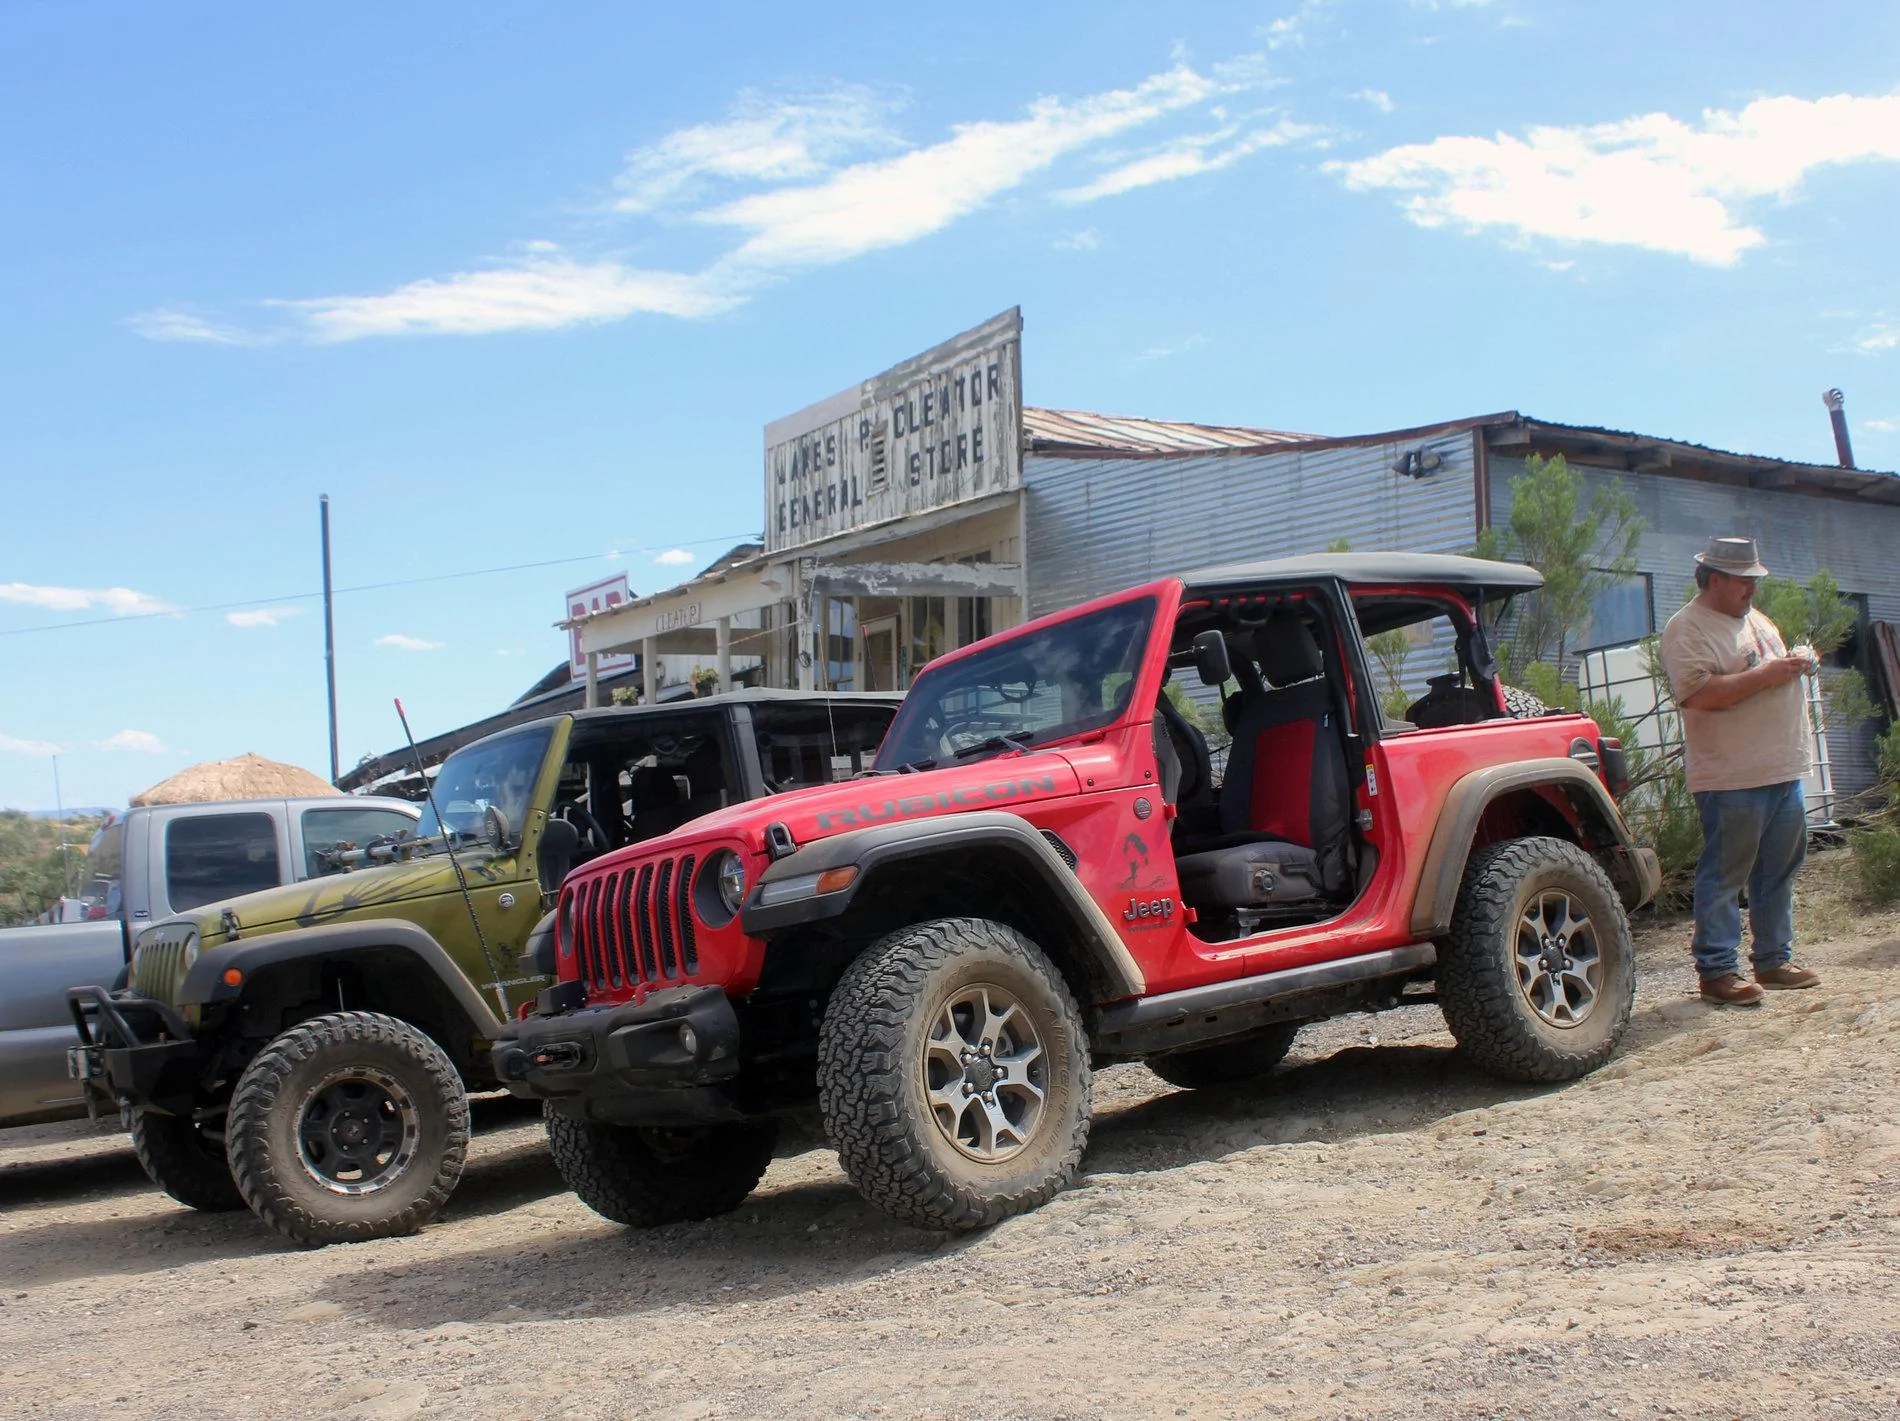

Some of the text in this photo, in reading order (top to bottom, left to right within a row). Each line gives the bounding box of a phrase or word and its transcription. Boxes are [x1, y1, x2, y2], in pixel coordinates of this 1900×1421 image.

[893, 363, 999, 439] CLEATOR
[778, 425, 984, 532] GENERAL STORE
[816, 774, 1056, 830] RUBICON
[1123, 897, 1175, 921] Jeep
